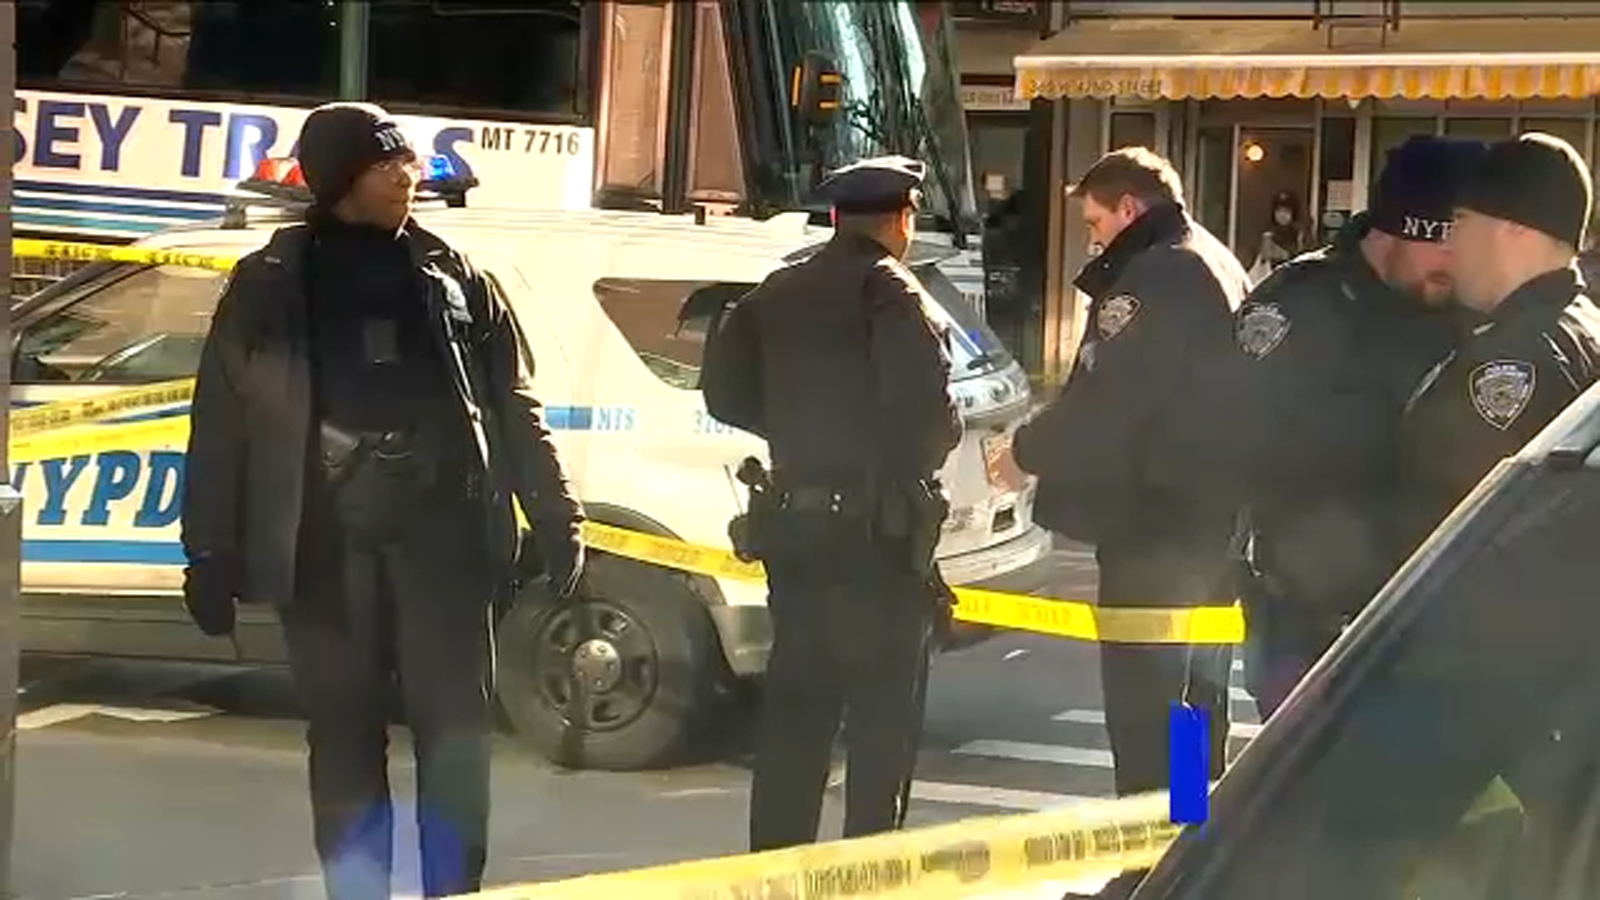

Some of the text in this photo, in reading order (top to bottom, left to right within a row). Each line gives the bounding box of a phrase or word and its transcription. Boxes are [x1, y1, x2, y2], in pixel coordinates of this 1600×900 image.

[481, 126, 580, 155] MT 7716
[1402, 216, 1454, 240] NYP
